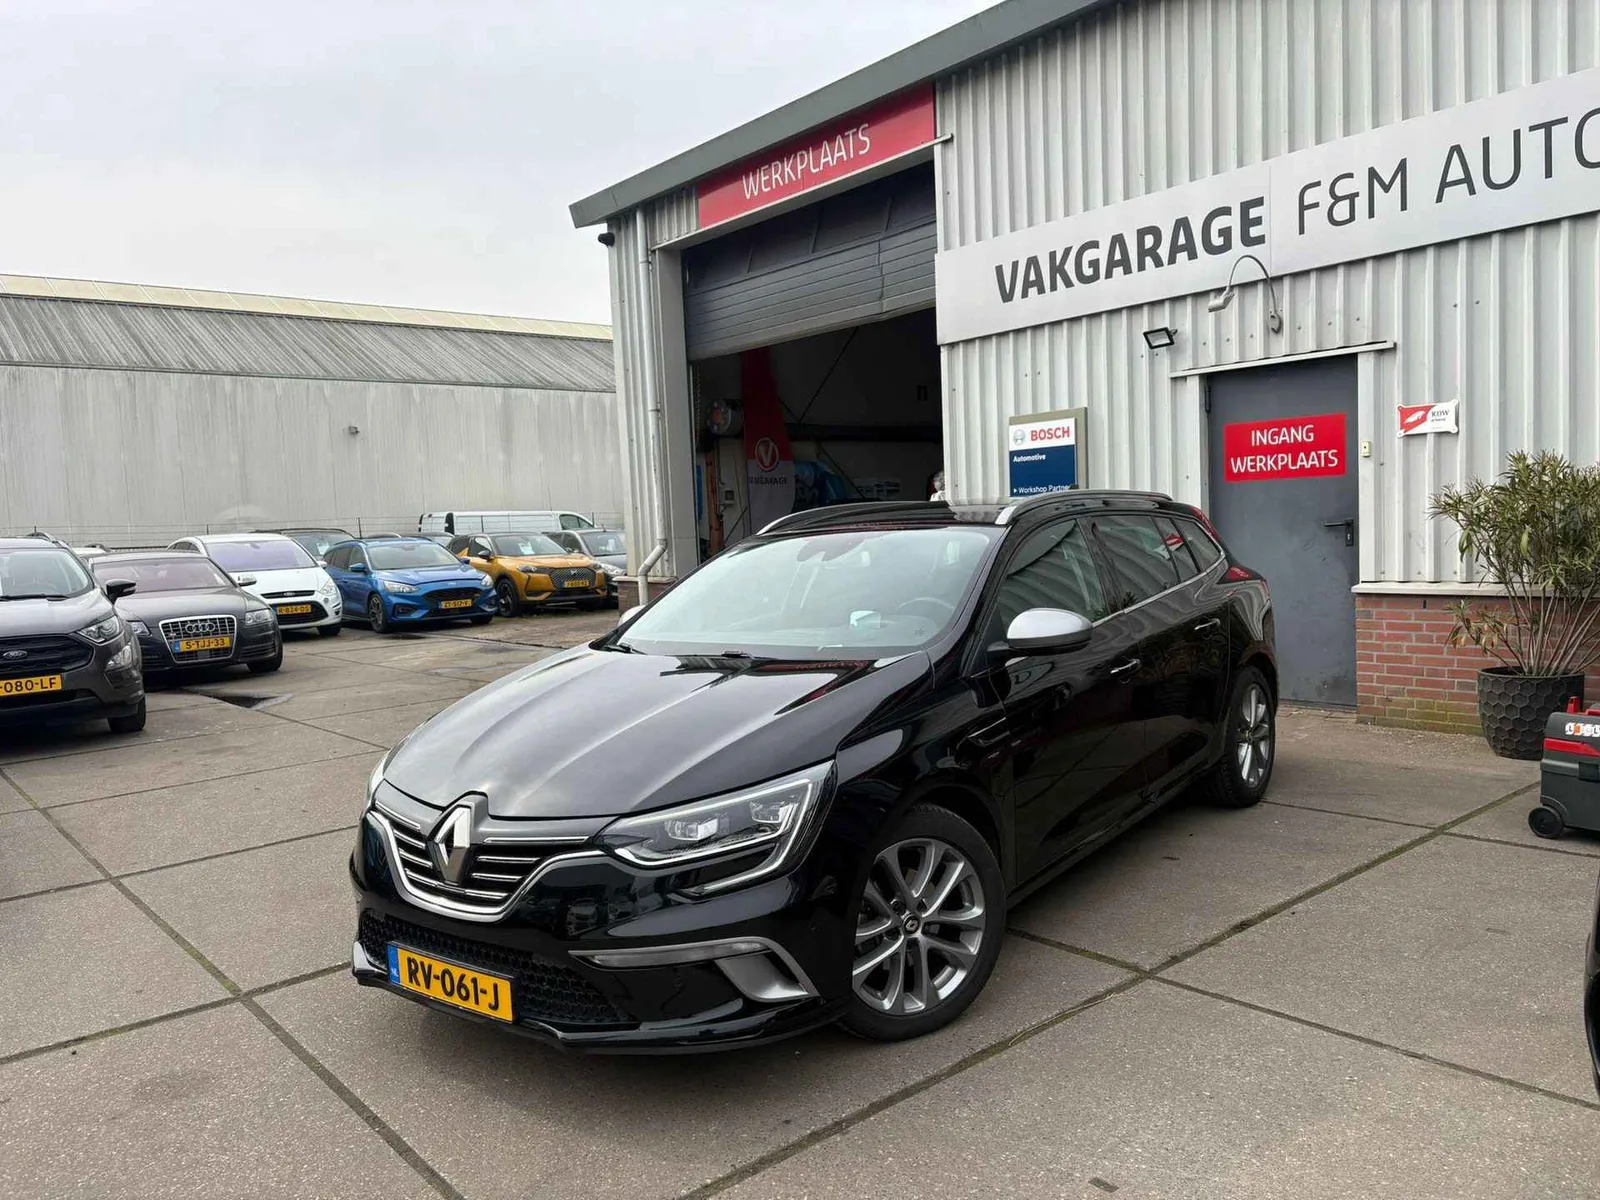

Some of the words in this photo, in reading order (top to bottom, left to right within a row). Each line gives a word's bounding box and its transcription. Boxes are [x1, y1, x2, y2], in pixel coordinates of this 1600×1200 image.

[742, 123, 871, 200] WERKPLAATS
[995, 196, 1266, 303] VAKGARAGE
[1298, 157, 1408, 236] F&M
[1030, 426, 1070, 441] BOSCH
[1251, 424, 1314, 447] INGANG
[1013, 453, 1046, 463] Automotive
[1230, 449, 1338, 474] WERKPLAATS
[1018, 485, 1047, 494] Workshop
[406, 956, 499, 1011] RV-061-J
